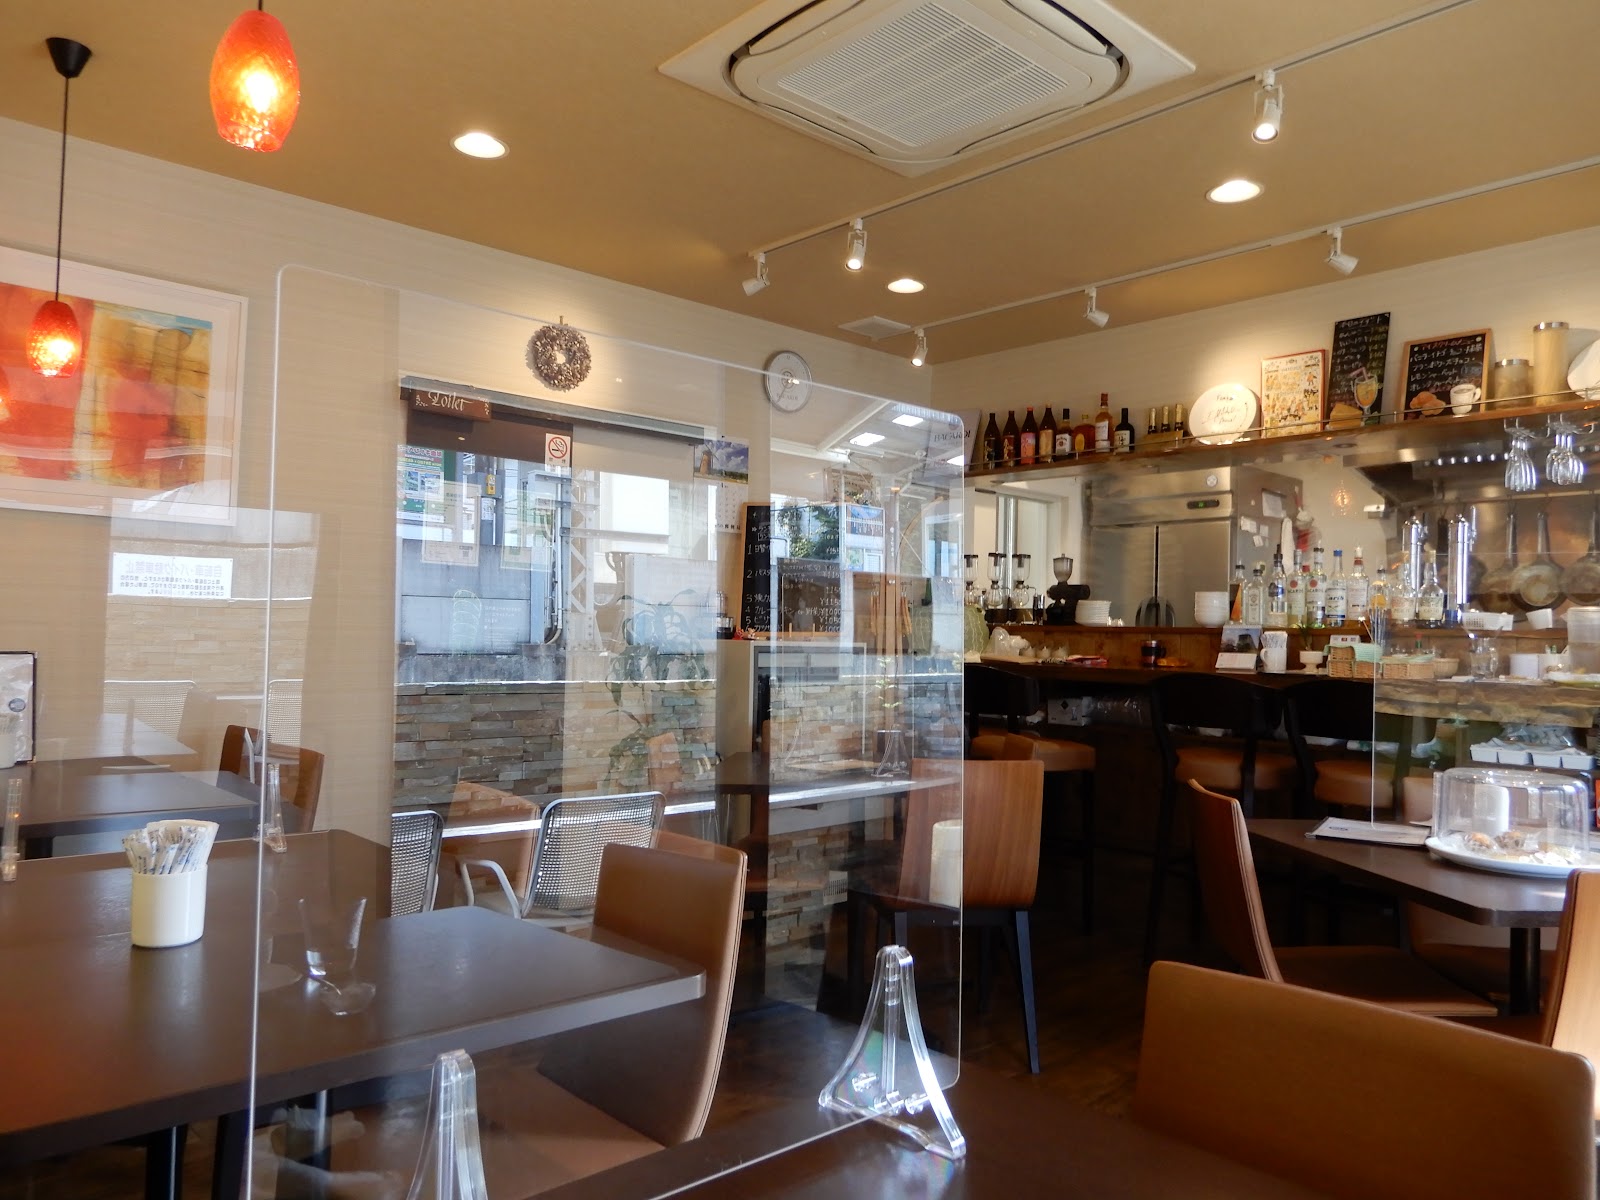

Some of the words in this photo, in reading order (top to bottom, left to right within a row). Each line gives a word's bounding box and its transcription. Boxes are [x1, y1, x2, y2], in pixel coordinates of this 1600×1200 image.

[428, 390, 474, 412] Toilet
[746, 569, 753, 579] 2
[745, 616, 752, 625] 5
